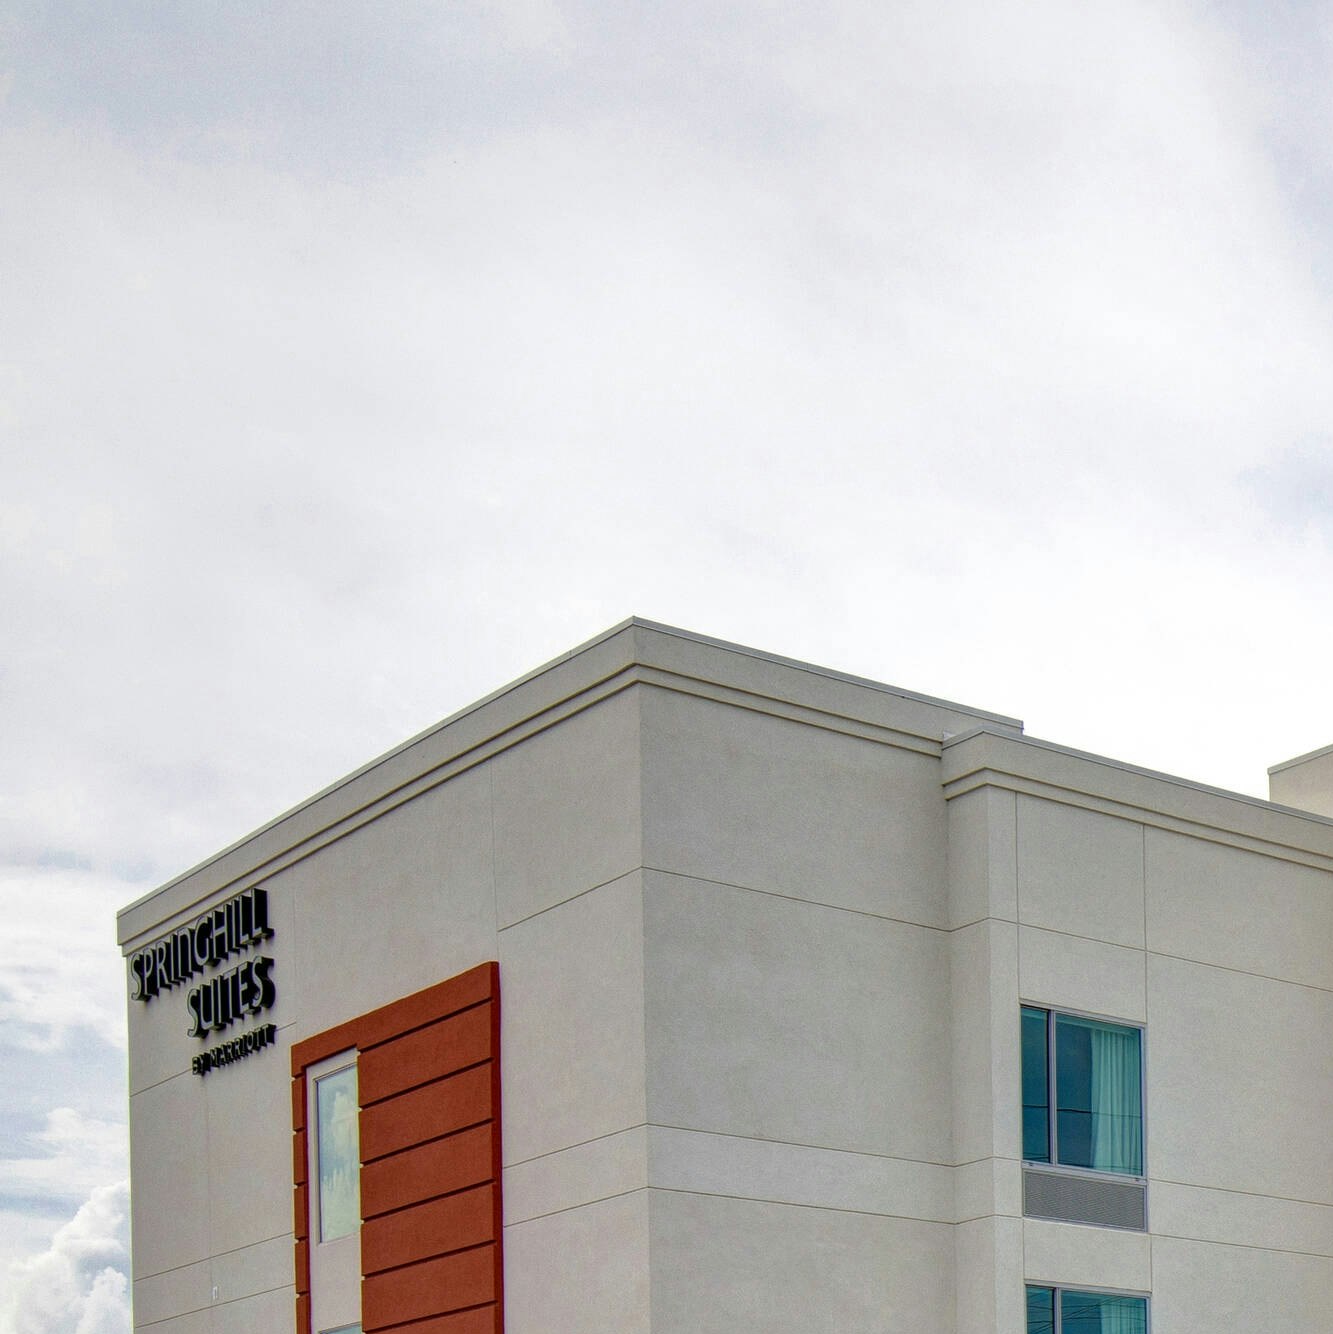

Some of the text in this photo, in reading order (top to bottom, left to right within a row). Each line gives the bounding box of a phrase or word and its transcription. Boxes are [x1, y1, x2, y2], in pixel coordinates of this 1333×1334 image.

[131, 888, 274, 1001] SPRINGHILL
[187, 956, 275, 1039] SUITES
[210, 1024, 276, 1068] MARRIOTT
